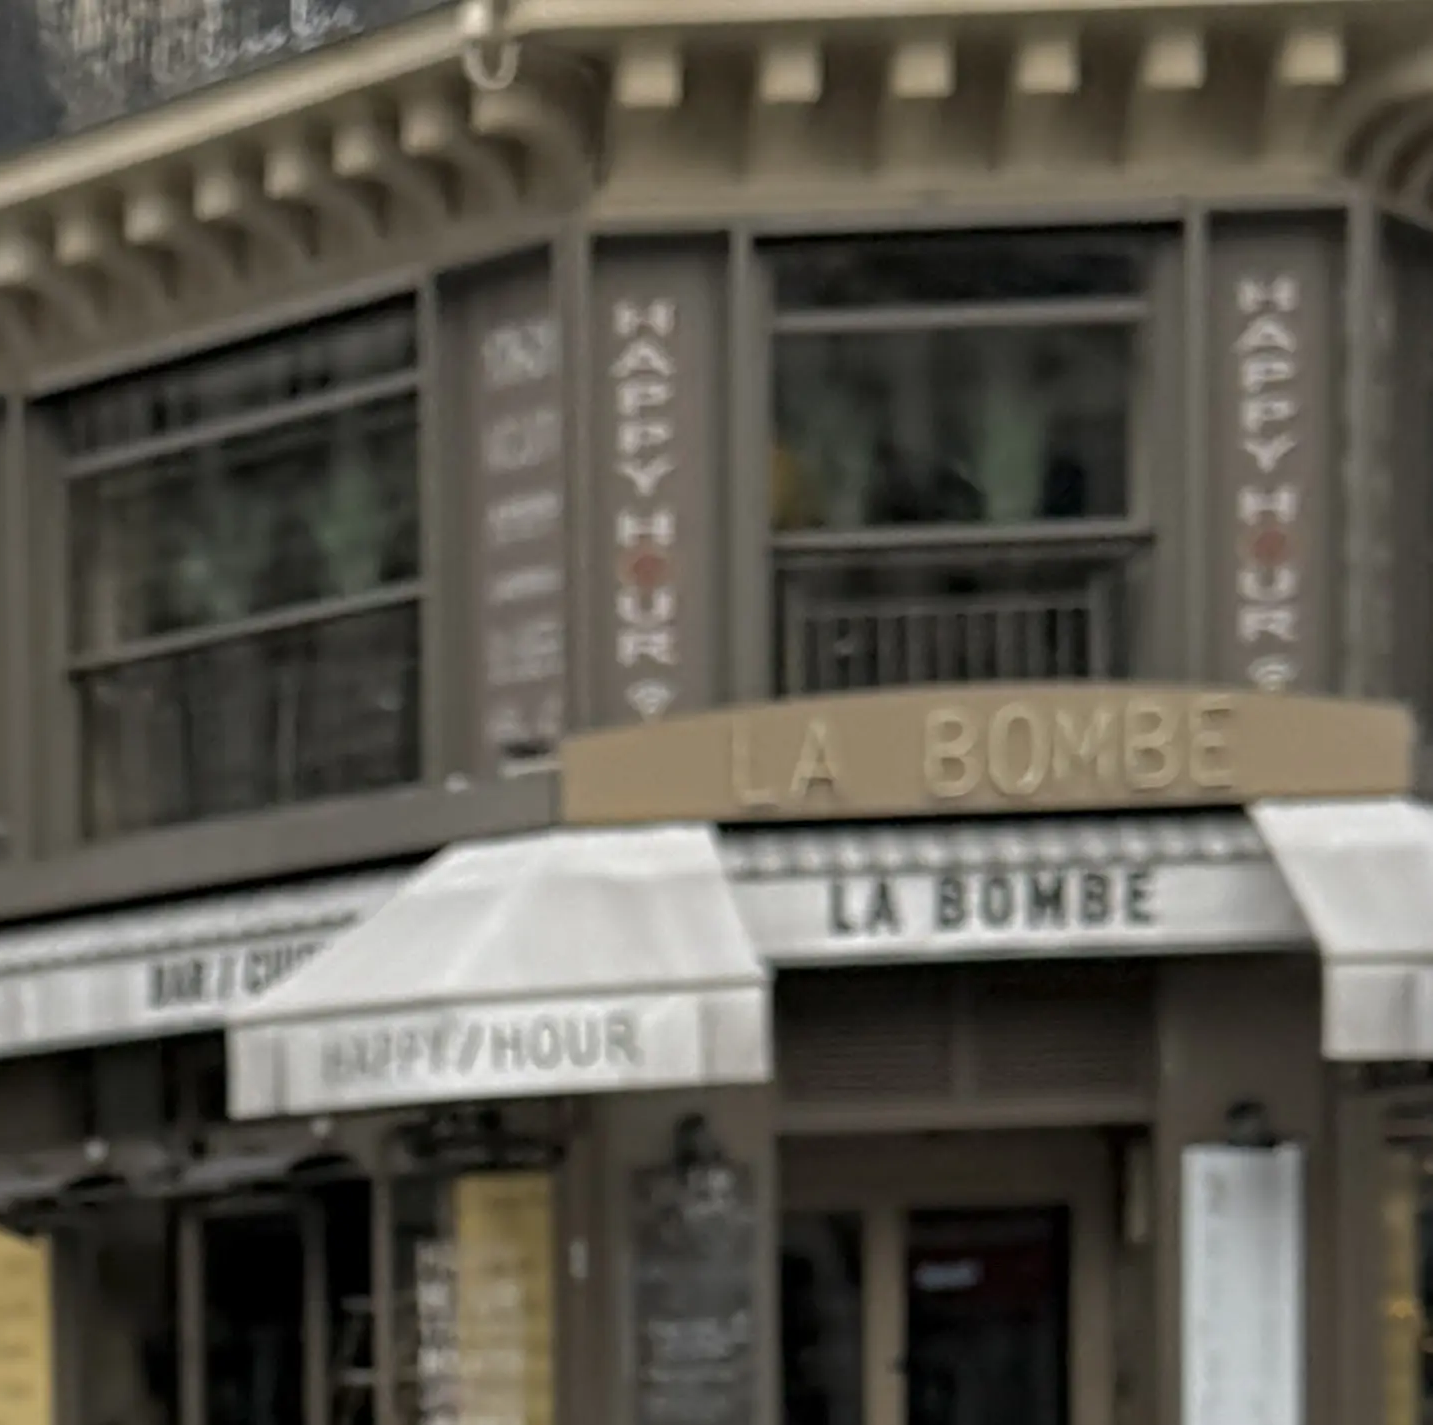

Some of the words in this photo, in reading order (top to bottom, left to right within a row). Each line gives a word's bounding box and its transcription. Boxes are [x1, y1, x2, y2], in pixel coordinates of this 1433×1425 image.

[611, 299, 676, 496] HAPPY
[1236, 275, 1299, 474] HAPPY
[732, 712, 839, 805] LA
[924, 698, 1237, 800] BOMBE
[829, 874, 899, 936] LA
[938, 866, 1157, 930] BOMBE
